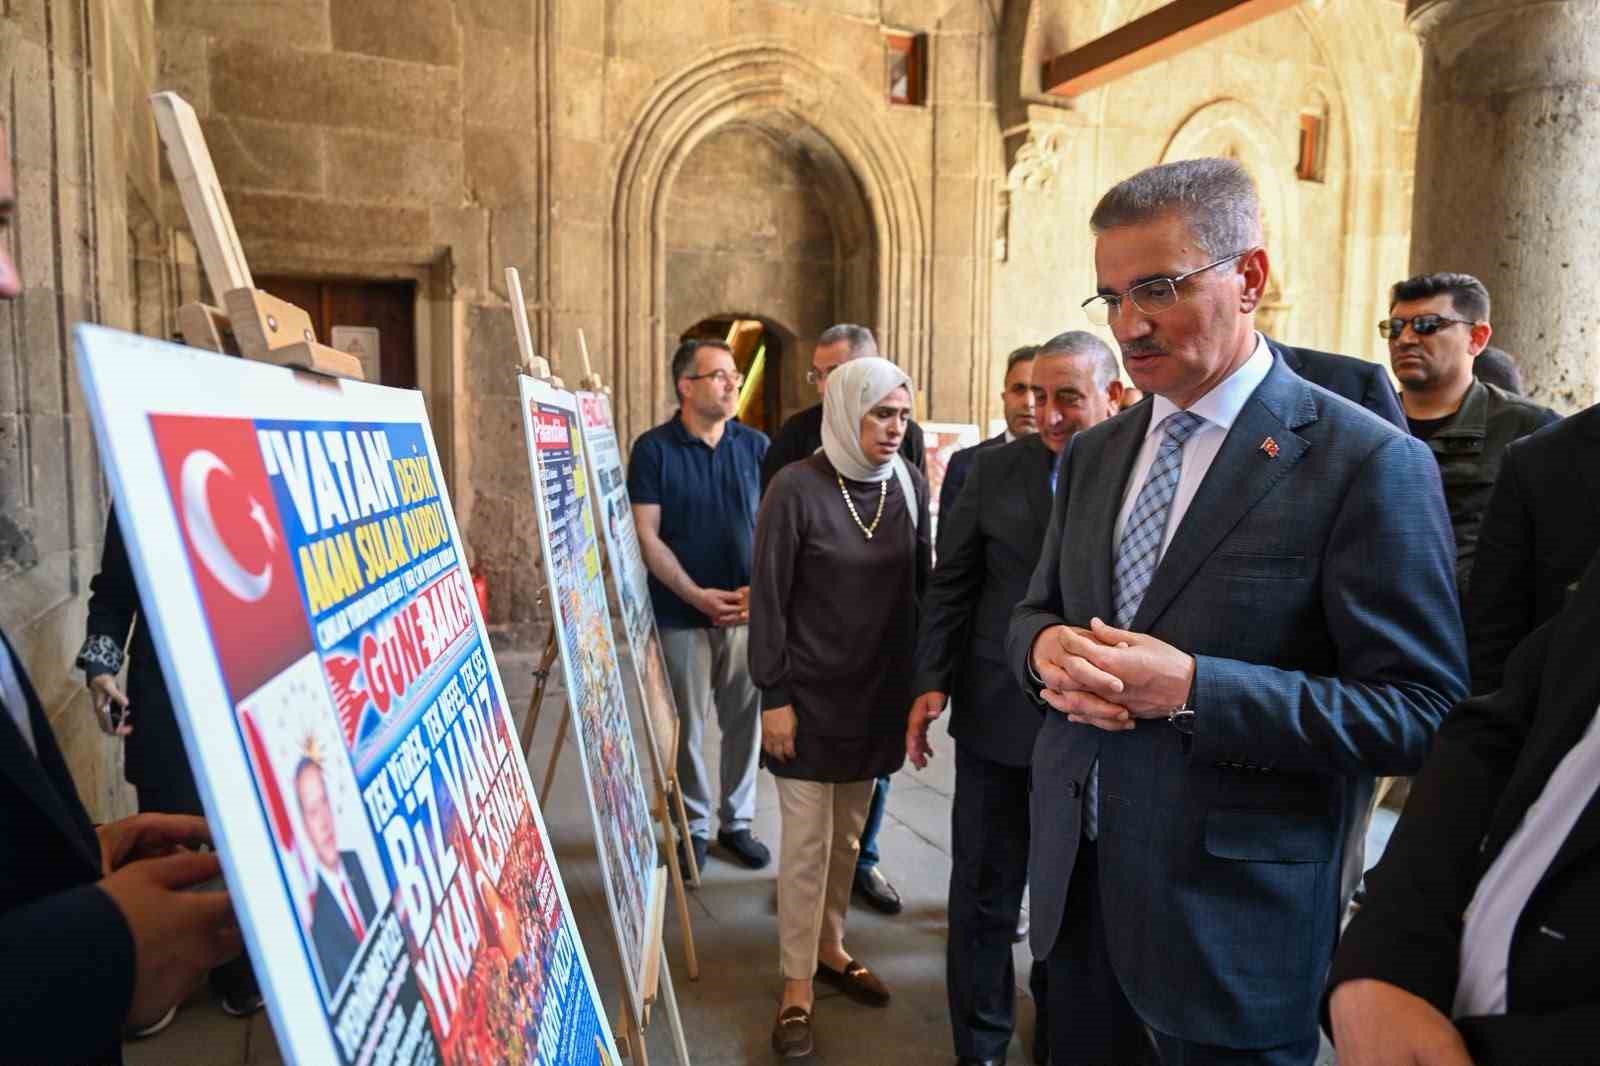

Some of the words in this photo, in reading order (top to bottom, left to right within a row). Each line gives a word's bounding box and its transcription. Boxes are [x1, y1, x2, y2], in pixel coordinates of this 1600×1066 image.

[393, 443, 438, 505] DEDİK
[299, 531, 365, 616] AKAN
[355, 516, 410, 584] SULAR
[402, 500, 450, 559] DURDU
[363, 767, 398, 833] TEK
[422, 700, 447, 750] TEK
[459, 656, 477, 697] TEK
[472, 645, 488, 680] SES
[383, 766, 460, 949] BİZ
[434, 676, 512, 838] VARIZ
[551, 911, 575, 1002] YAZDI
